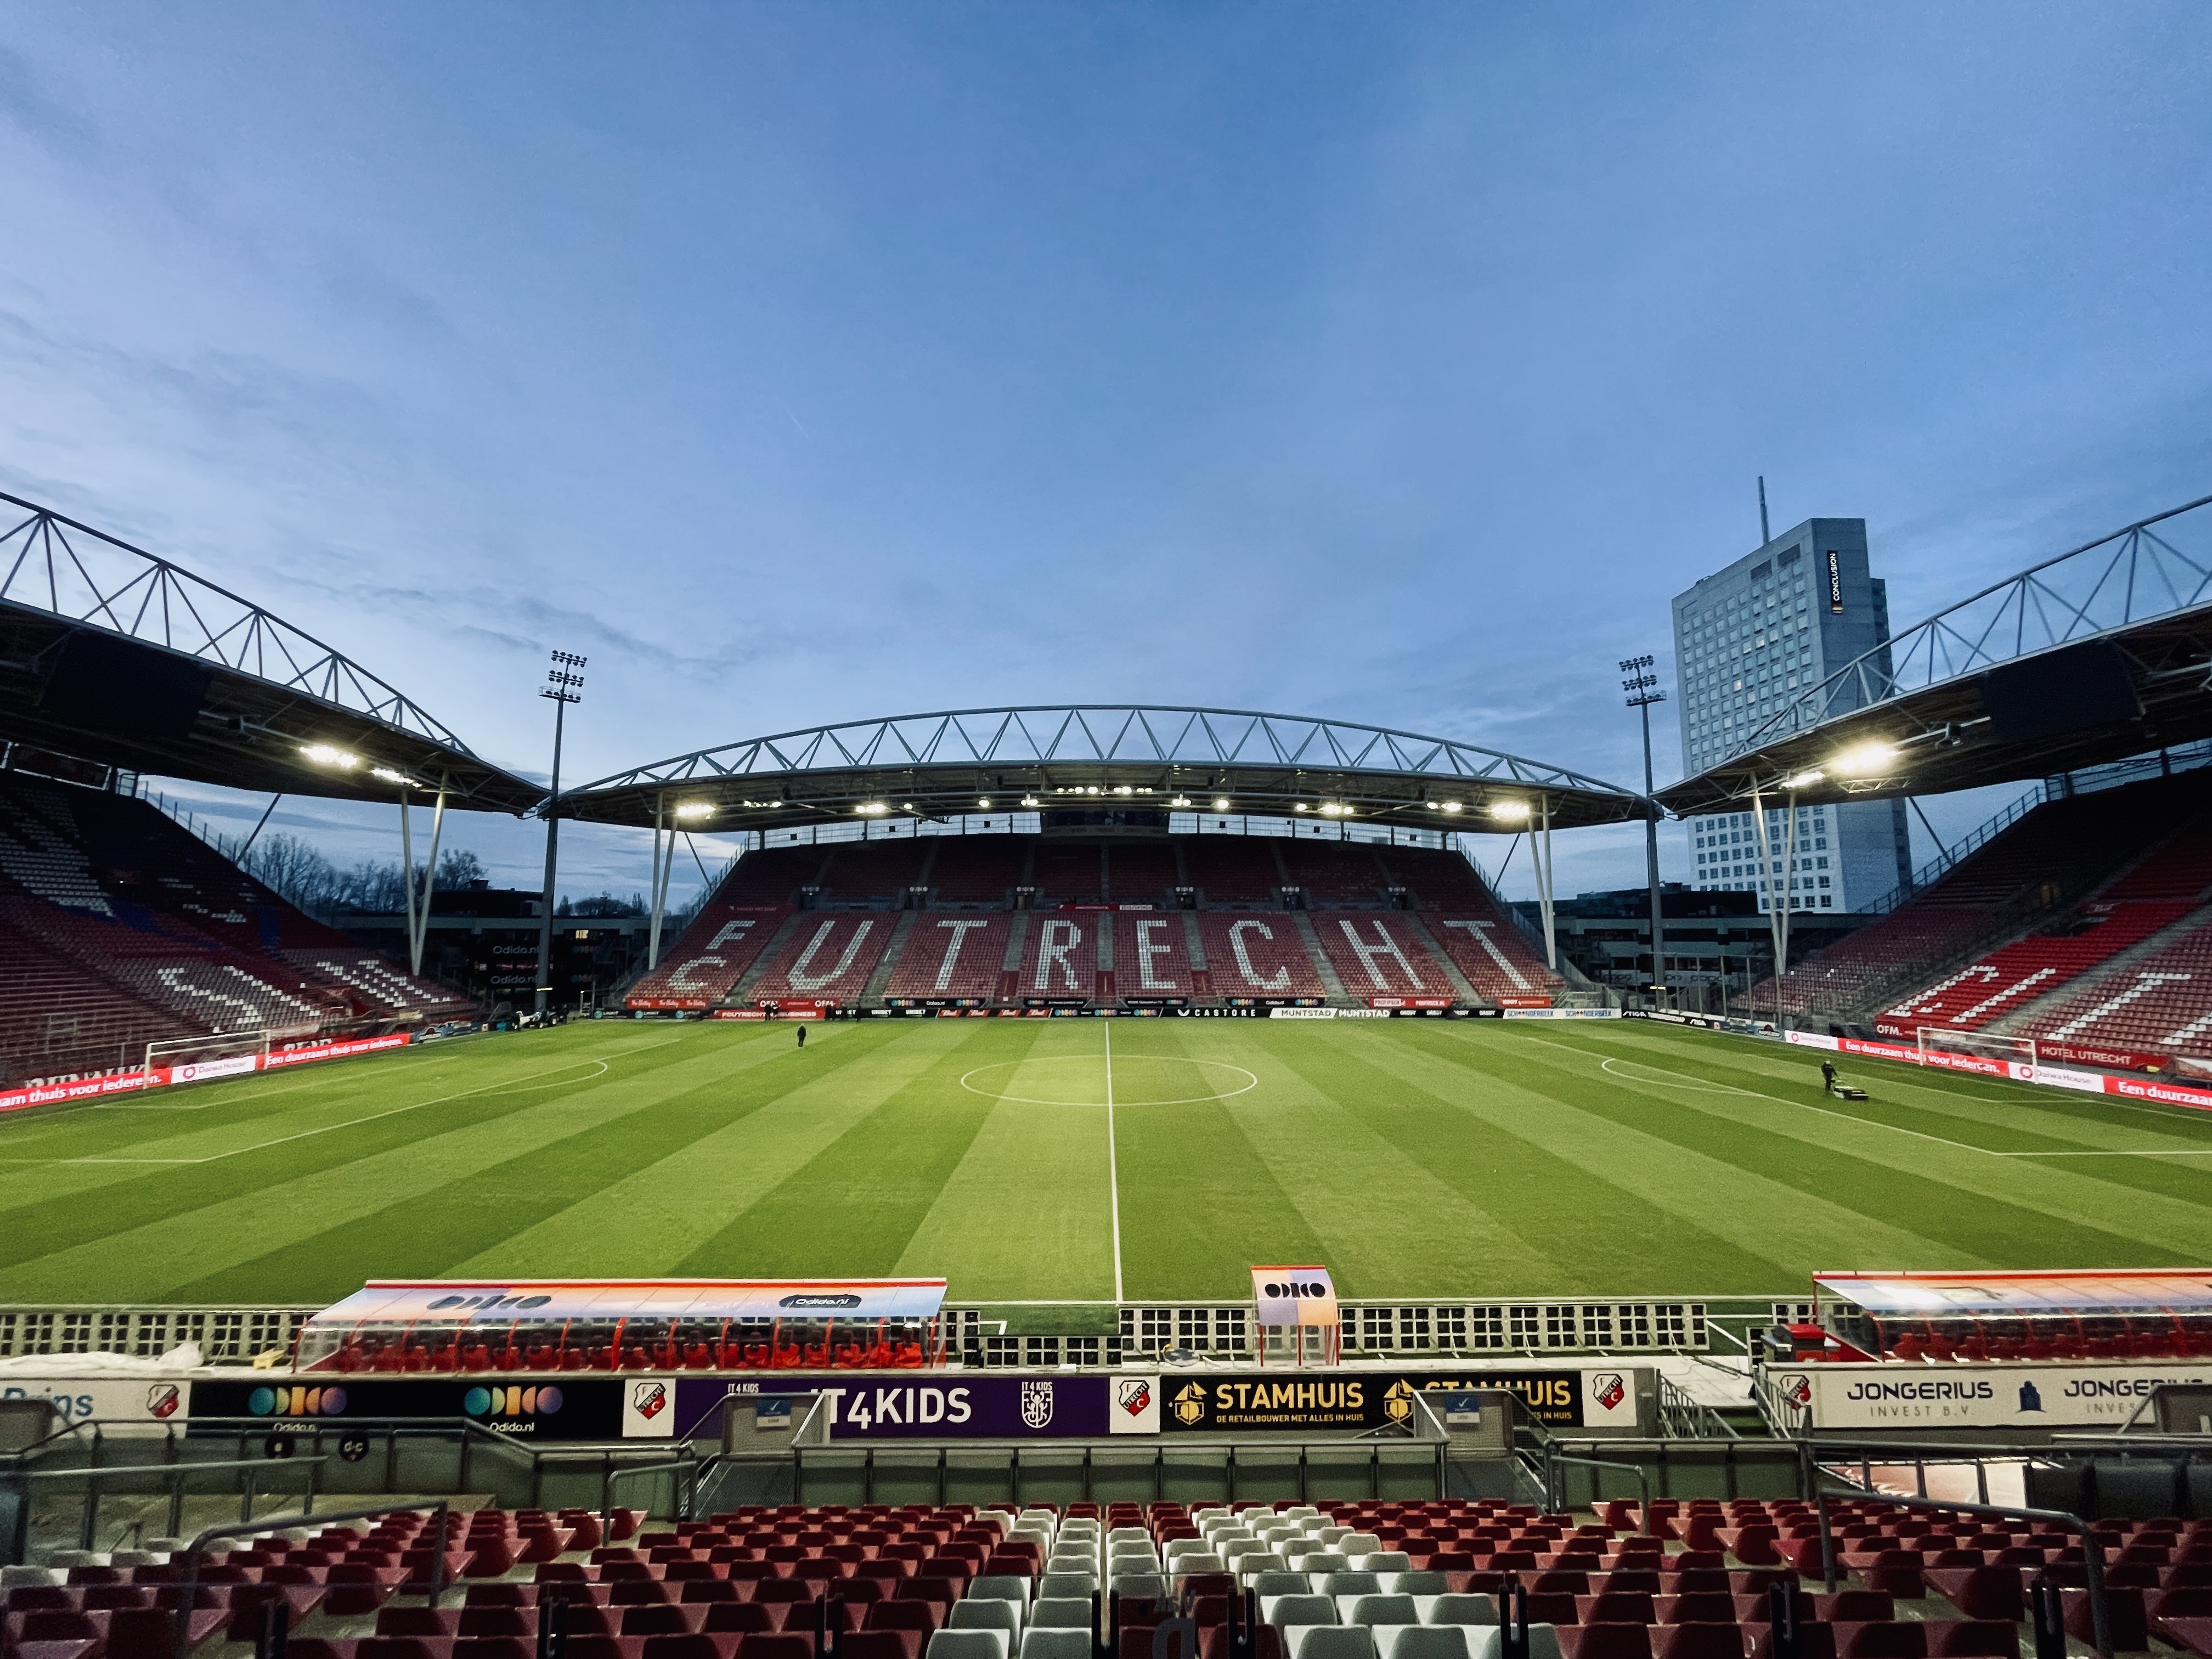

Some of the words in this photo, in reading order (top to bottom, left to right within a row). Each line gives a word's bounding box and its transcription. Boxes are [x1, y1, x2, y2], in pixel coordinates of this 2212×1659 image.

[1830, 553, 1840, 601] CONCLUSION
[706, 920, 756, 950] F
[787, 919, 1533, 991] UTRECHT
[667, 956, 727, 991] C
[1876, 1024, 1903, 1036] OFM.
[266, 1055, 284, 1065] Een
[285, 1049, 329, 1063] duurzaam
[329, 1045, 351, 1056] thuis
[351, 1043, 370, 1052] voor
[1846, 1041, 1861, 1051] Een
[1861, 1043, 1904, 1058] duurzaam
[1904, 1049, 1927, 1062] thus
[1928, 1055, 1950, 1065] voor
[2041, 1047, 2076, 1059] HOTEL
[2077, 1050, 2131, 1065] UTRECHT
[2036, 1069, 2062, 1080] Daiwa
[2063, 1074, 2091, 1085] House
[29, 1087, 66, 1103] thuis
[69, 1084, 101, 1096] voor
[102, 1075, 162, 1092] iederen.
[2118, 1081, 2145, 1096] Een
[2147, 1086, 2212, 1107] duurzaa
[727, 1383, 735, 1393] IT
[736, 1383, 741, 1393] 4
[742, 1383, 759, 1393] KIDS
[1022, 1381, 1029, 1391] IT
[1030, 1381, 1035, 1391] 4
[1036, 1381, 1053, 1391] KIDS
[1126, 1384, 1131, 1392] F
[1600, 1378, 1605, 1386] F
[1786, 1378, 1791, 1387] F
[2064, 1379, 2203, 1397] JONGE
[1123, 1383, 1148, 1409] UTRECHT
[1216, 1382, 1364, 1409] STAMHUIS
[1611, 1391, 1618, 1402] C
[1847, 1382, 1993, 1400] JONGERIUS
[651, 1401, 659, 1411] C
[811, 1388, 972, 1430] T4KIDS
[1136, 1398, 1144, 1408] C
[1870, 1406, 1931, 1417] INVEST
[1943, 1406, 1975, 1417] B.V.
[1228, 1414, 1290, 1423] RETAILBOUWER
[1345, 1413, 1364, 1421] HUIS
[1553, 1412, 1572, 1420] HUIS
[489, 1421, 535, 1432] Odido.nl
